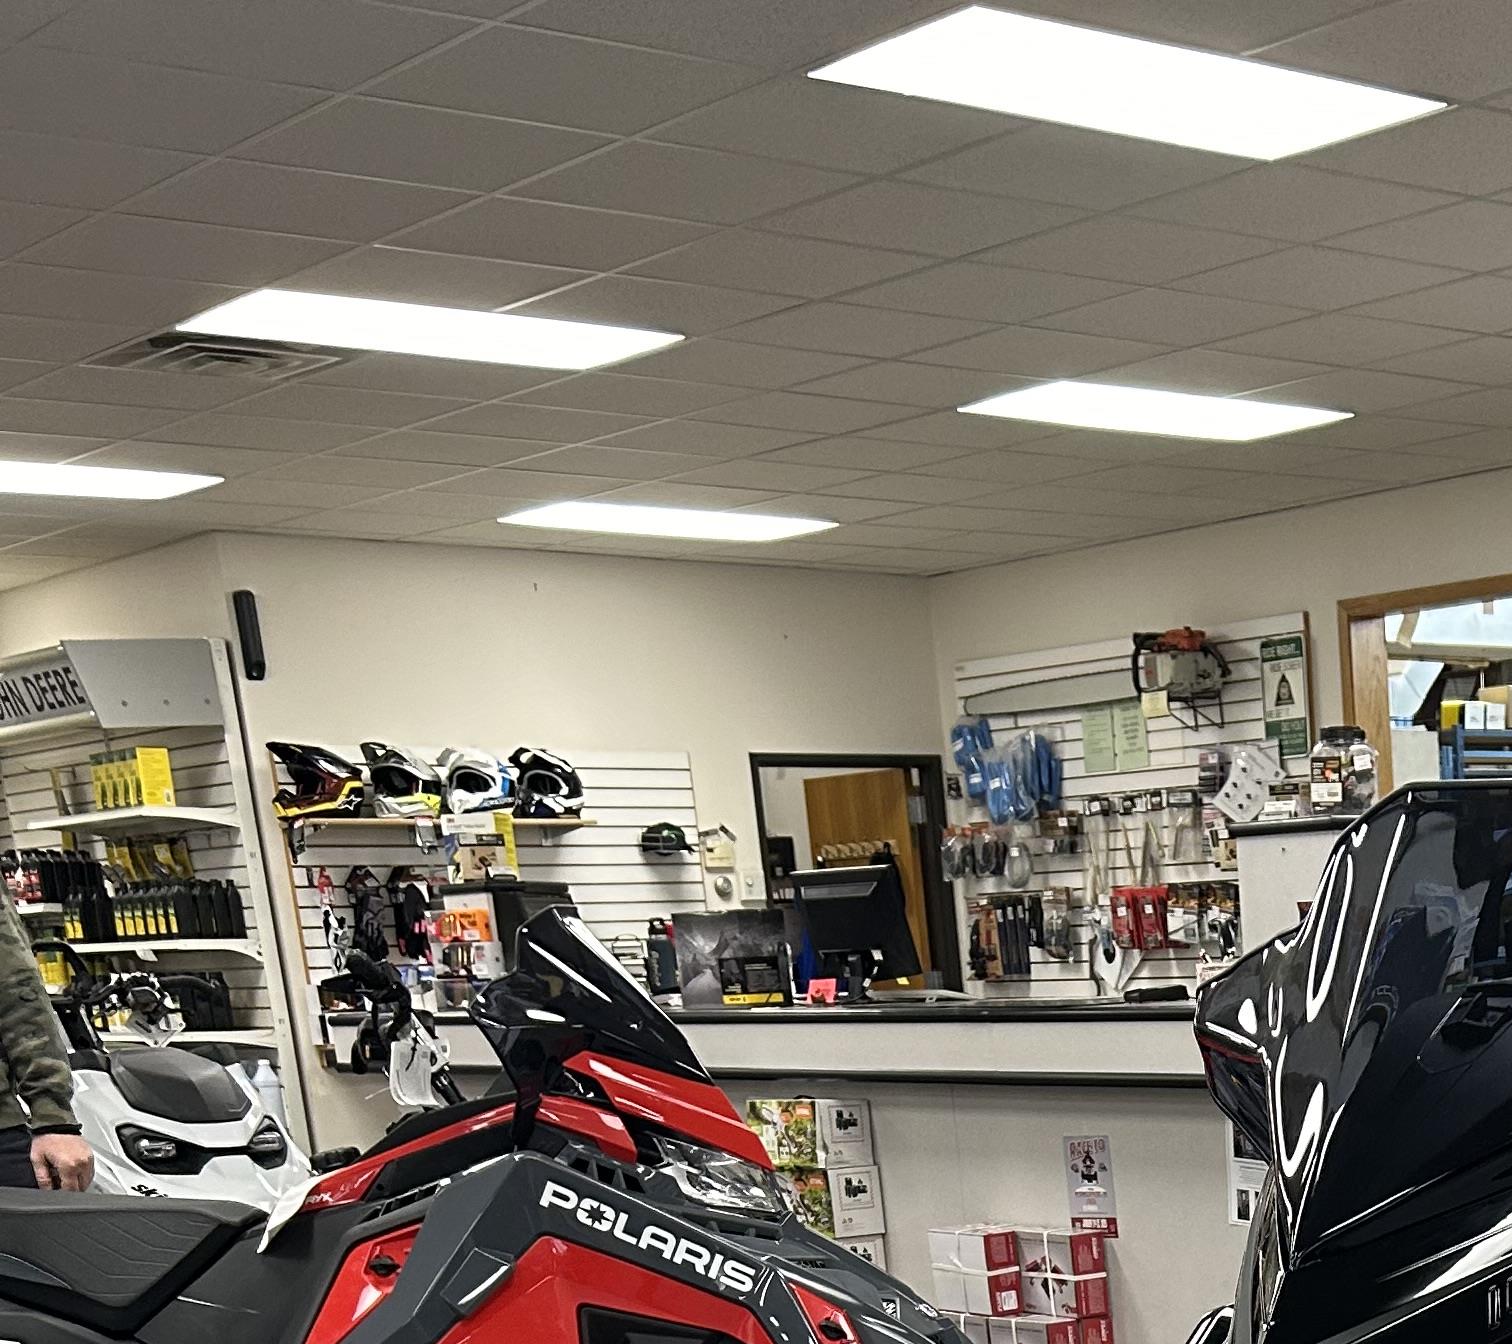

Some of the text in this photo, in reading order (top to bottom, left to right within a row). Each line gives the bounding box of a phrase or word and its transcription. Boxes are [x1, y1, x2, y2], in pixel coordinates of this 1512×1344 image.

[0, 666, 86, 720] HN DEERE
[538, 1180, 756, 1293] POLARIS
